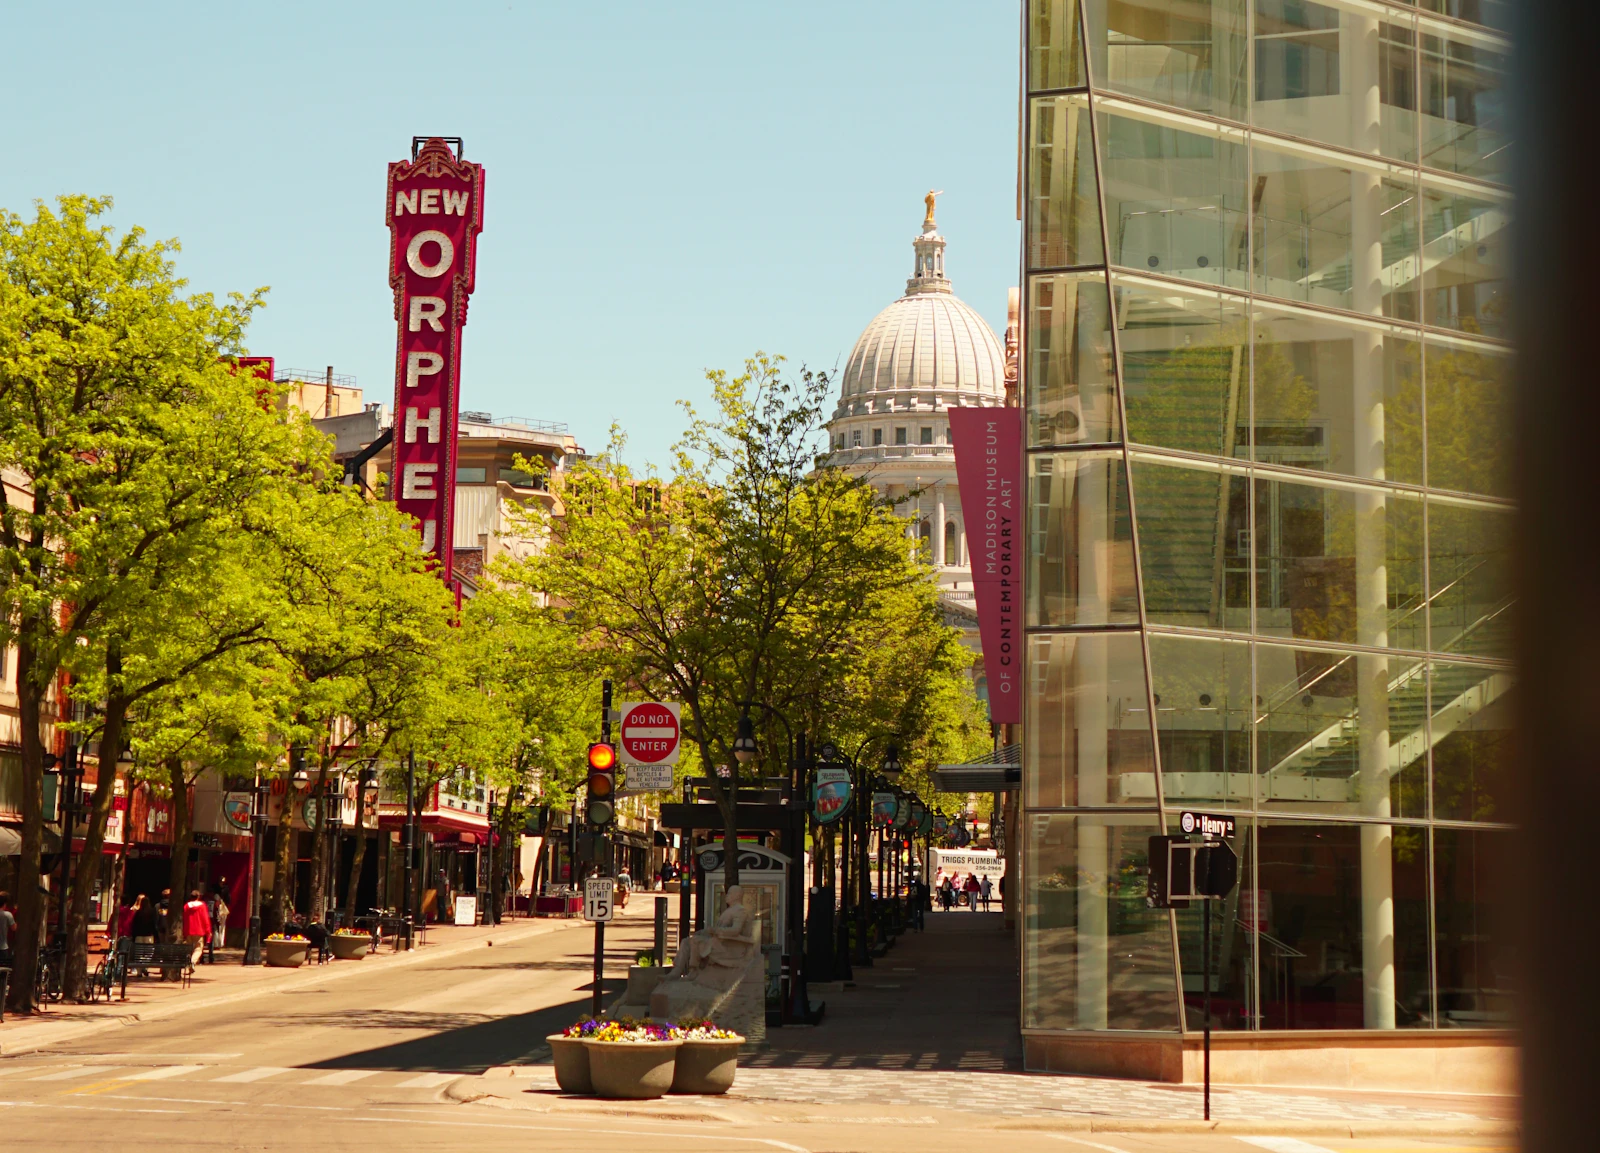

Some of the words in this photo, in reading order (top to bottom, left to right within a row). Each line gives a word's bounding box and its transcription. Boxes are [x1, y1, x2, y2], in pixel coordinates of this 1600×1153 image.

[395, 188, 470, 217] NEW
[985, 421, 997, 491] MUSEUM
[1001, 478, 1012, 508] ART
[985, 497, 997, 574] MADISON
[1001, 515, 1012, 667] CONTEMPORARY
[1000, 672, 1011, 694] OF
[631, 714, 646, 724] DO
[648, 714, 670, 724] NOT
[632, 741, 668, 751] ENTER
[1201, 815, 1226, 837] Henry
[942, 856, 966, 864] TRIGGS
[967, 857, 1002, 865] PLUMBING
[588, 882, 611, 890] SPEED
[589, 900, 608, 917] 15
